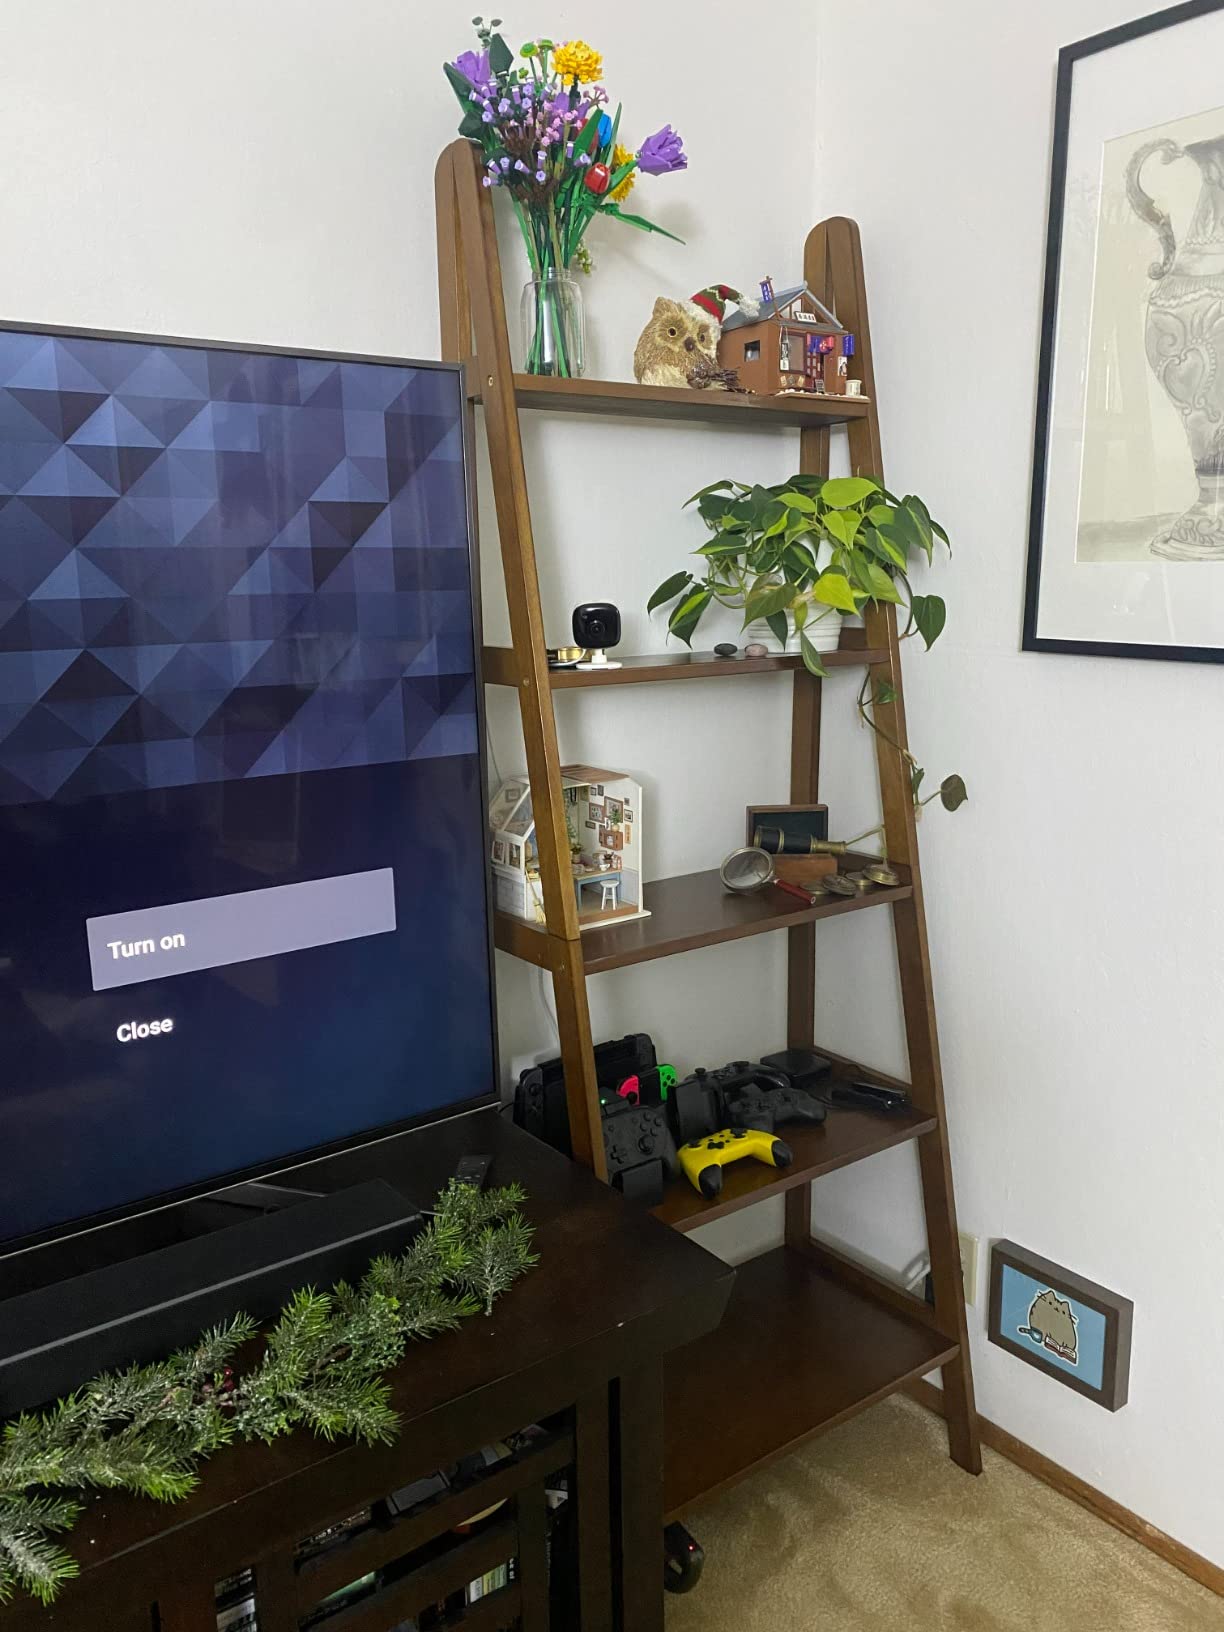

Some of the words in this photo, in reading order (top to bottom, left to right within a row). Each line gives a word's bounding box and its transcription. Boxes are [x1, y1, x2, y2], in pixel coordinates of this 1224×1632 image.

[107, 939, 155, 960] Turn
[160, 933, 185, 950] on
[117, 1018, 173, 1042] Close
